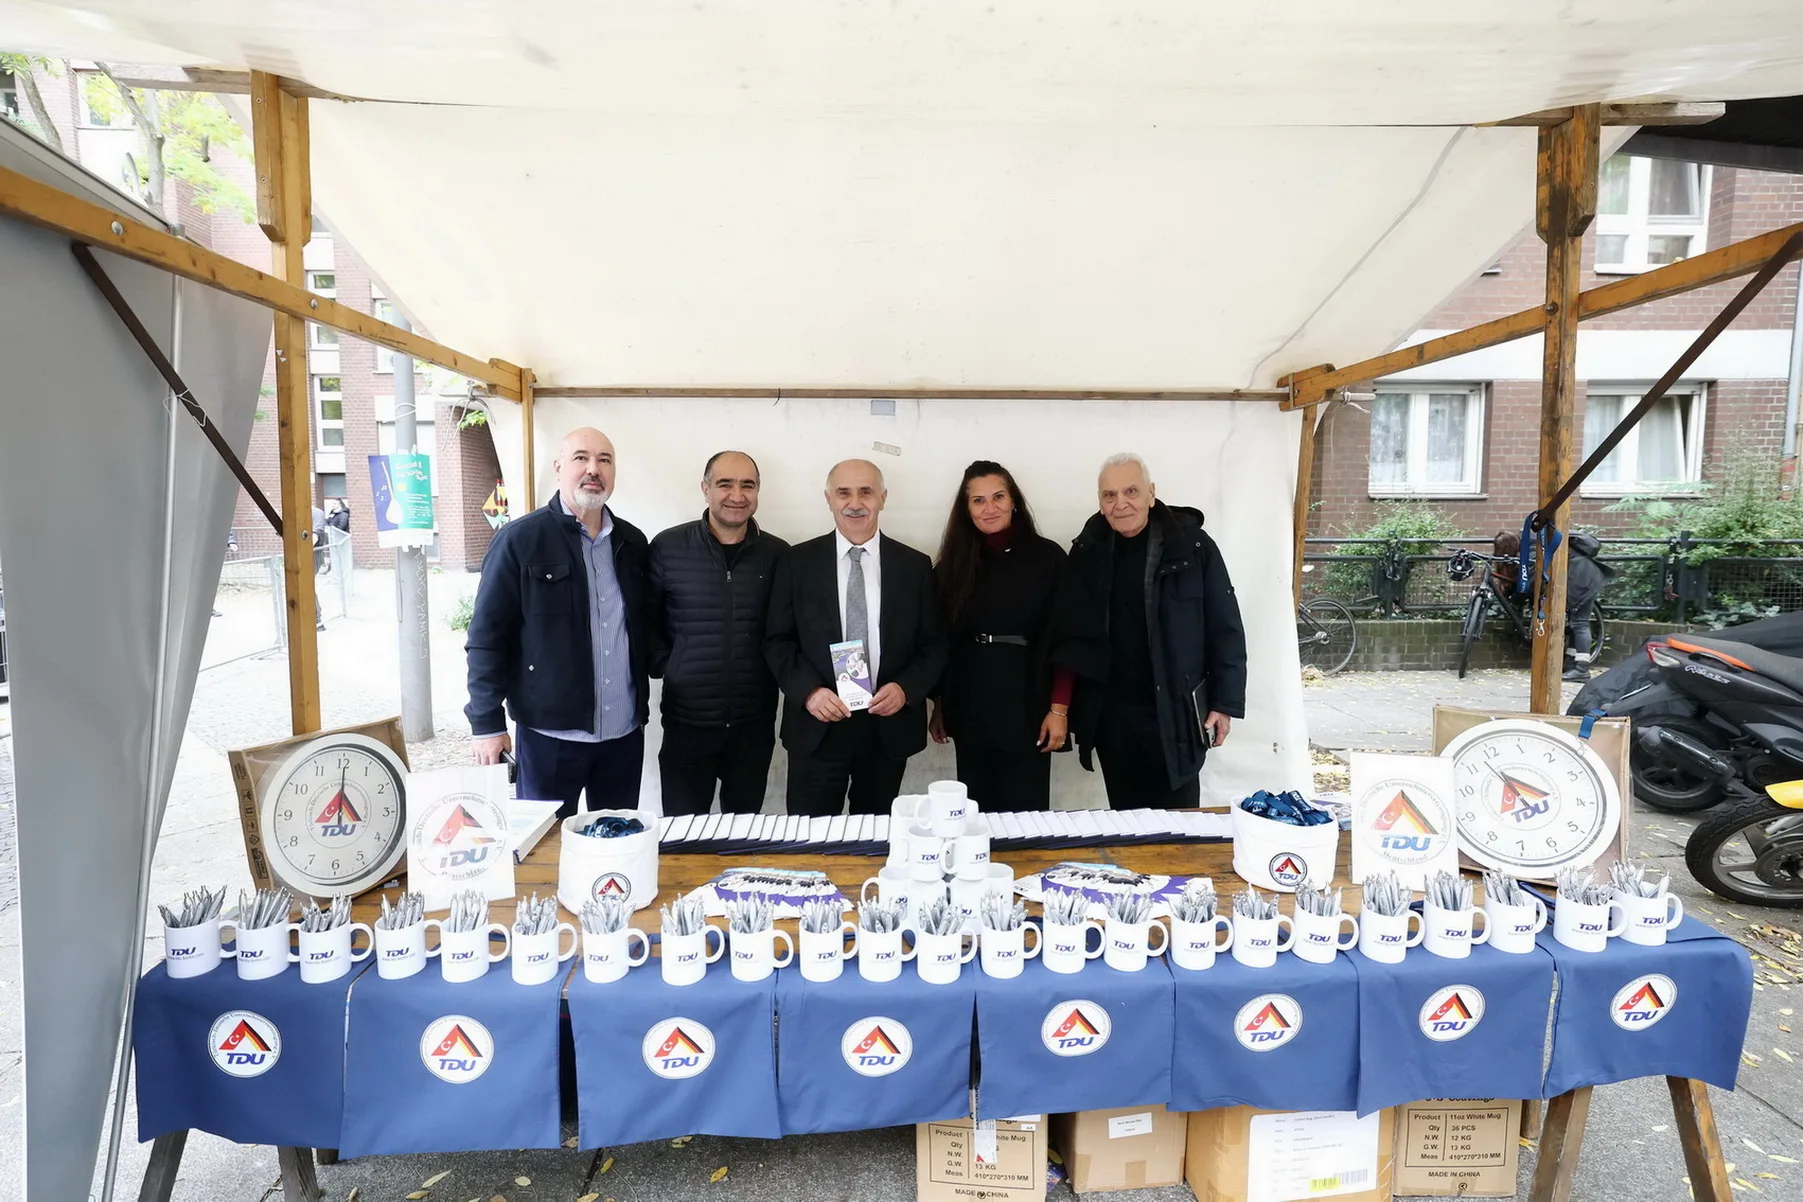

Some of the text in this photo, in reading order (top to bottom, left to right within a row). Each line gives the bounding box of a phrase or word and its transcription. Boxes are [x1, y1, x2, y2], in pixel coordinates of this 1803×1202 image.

[1483, 746, 1500, 760] 12
[1516, 743, 1525, 754] 1
[1543, 752, 1556, 764] 2
[337, 759, 350, 768] 12
[315, 766, 325, 776] 11
[364, 767, 369, 776] 1
[1466, 763, 1479, 776] 11
[1566, 770, 1579, 782] 3
[294, 784, 308, 795] 10
[377, 784, 384, 794] 2
[1459, 784, 1475, 798] 10
[1575, 797, 1587, 808] 4
[284, 810, 293, 821] 9
[382, 807, 390, 818] 3
[950, 808, 965, 816] TDU
[1465, 811, 1476, 822] 9
[1510, 800, 1550, 823] TDU
[320, 824, 356, 837] TDU
[1567, 821, 1579, 833] 5
[374, 832, 381, 842] 4
[1487, 830, 1498, 842] 8
[289, 836, 298, 847] 8
[1380, 834, 1431, 851] TDU
[1516, 840, 1526, 851] 7
[1545, 837, 1557, 848] 6
[308, 854, 316, 865] 7
[356, 851, 364, 861] 5
[331, 859, 340, 870] 6
[1515, 924, 1533, 932] TDU
[1580, 923, 1602, 931] TDU
[1310, 933, 1331, 942] TDU
[1446, 929, 1467, 937] TDU
[1056, 944, 1075, 952] TDU
[1115, 940, 1134, 949] TDU
[1190, 941, 1209, 949] TDU
[171, 947, 196, 956] TDU
[240, 950, 263, 958] TDU
[310, 950, 334, 960] TDU
[386, 947, 409, 957] TDU
[452, 951, 474, 959] TDU
[735, 951, 753, 959] TDU
[819, 950, 837, 959] TDU
[876, 951, 895, 959] TDU
[528, 953, 549, 962] TDU
[679, 952, 698, 962] TDU
[938, 953, 956, 961] TDU
[1624, 1010, 1658, 1022] TDU
[1432, 1021, 1466, 1032] TDU
[1250, 1030, 1285, 1042] TDU
[1058, 1037, 1094, 1048] TDU
[227, 1053, 266, 1065] TDU
[662, 1056, 699, 1070] TDU
[859, 1056, 895, 1066] TDU
[439, 1058, 476, 1071] TDU
[935, 1129, 963, 1138] Product
[945, 1169, 963, 1177] Meas
[955, 1189, 975, 1197] MADE
